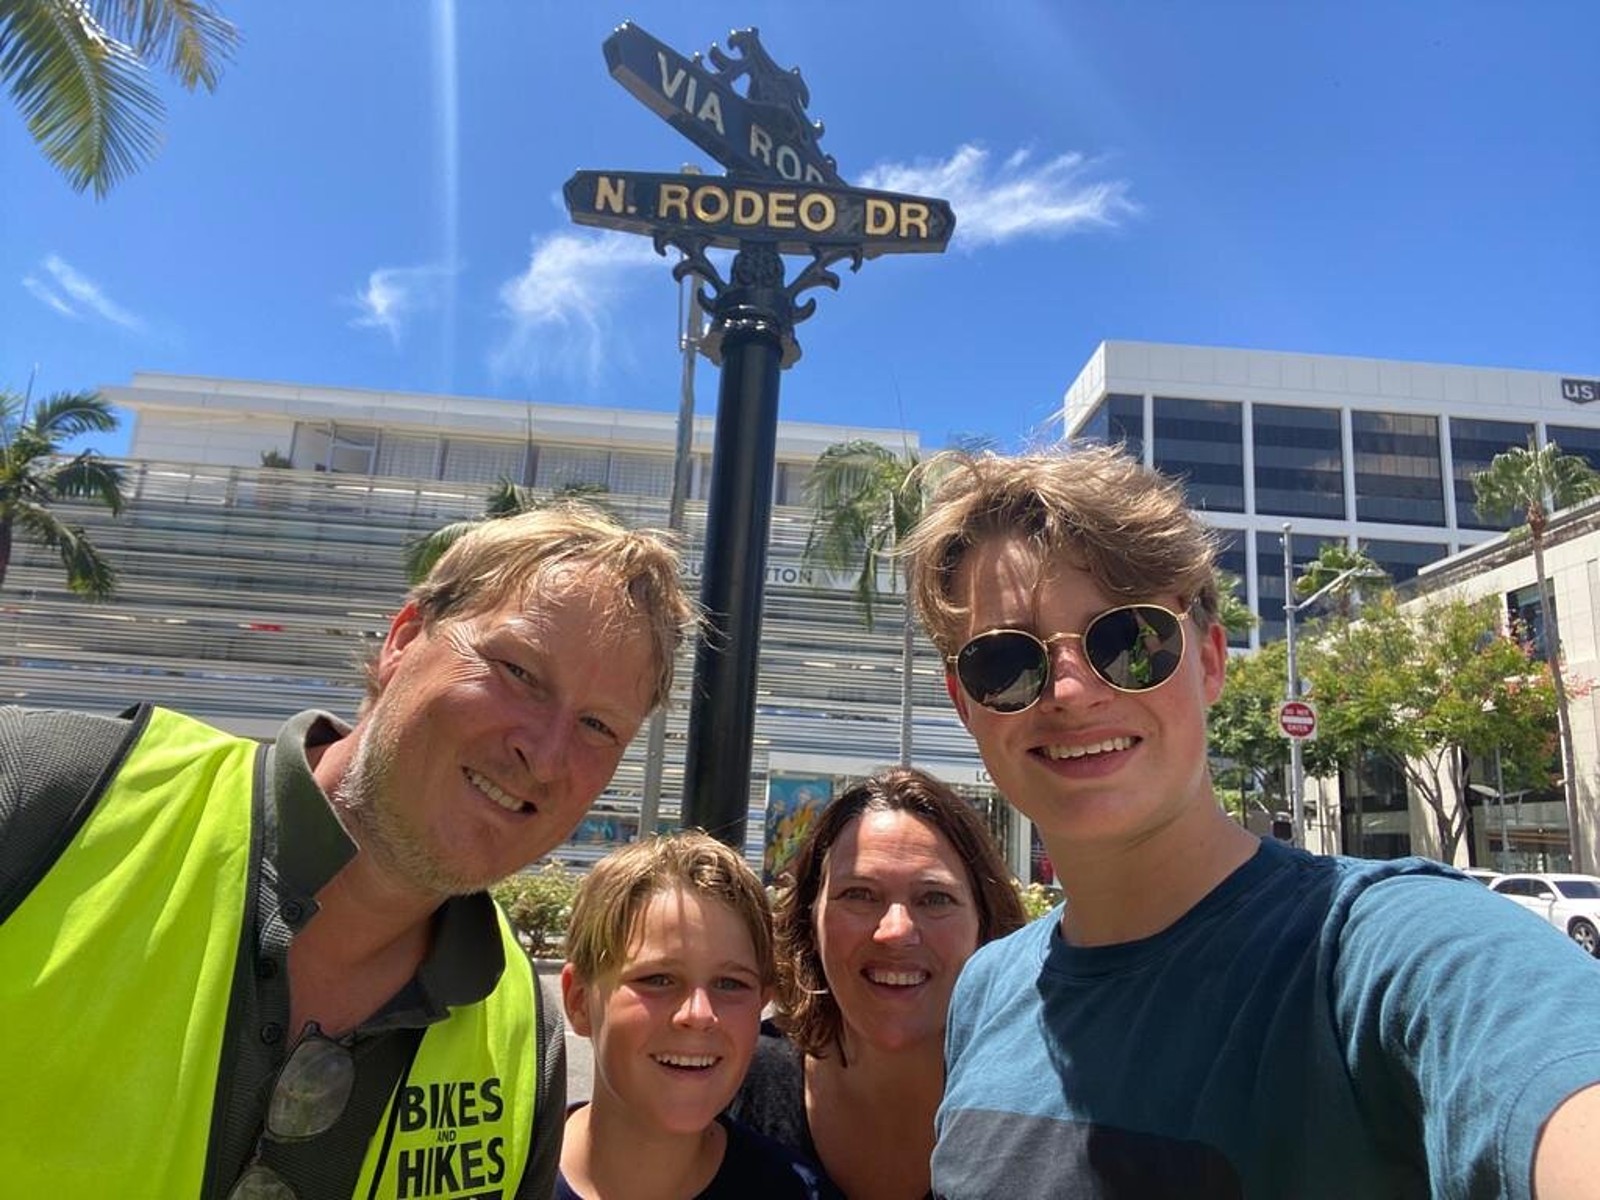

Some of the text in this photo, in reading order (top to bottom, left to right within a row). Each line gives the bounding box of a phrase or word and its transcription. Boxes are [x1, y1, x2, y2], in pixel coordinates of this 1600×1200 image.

[657, 51, 725, 136] VIA
[594, 175, 930, 239] N. RODEO DR
[400, 1077, 504, 1133] BIKES
[435, 1130, 457, 1142] AND
[397, 1136, 506, 1199] HIKES
